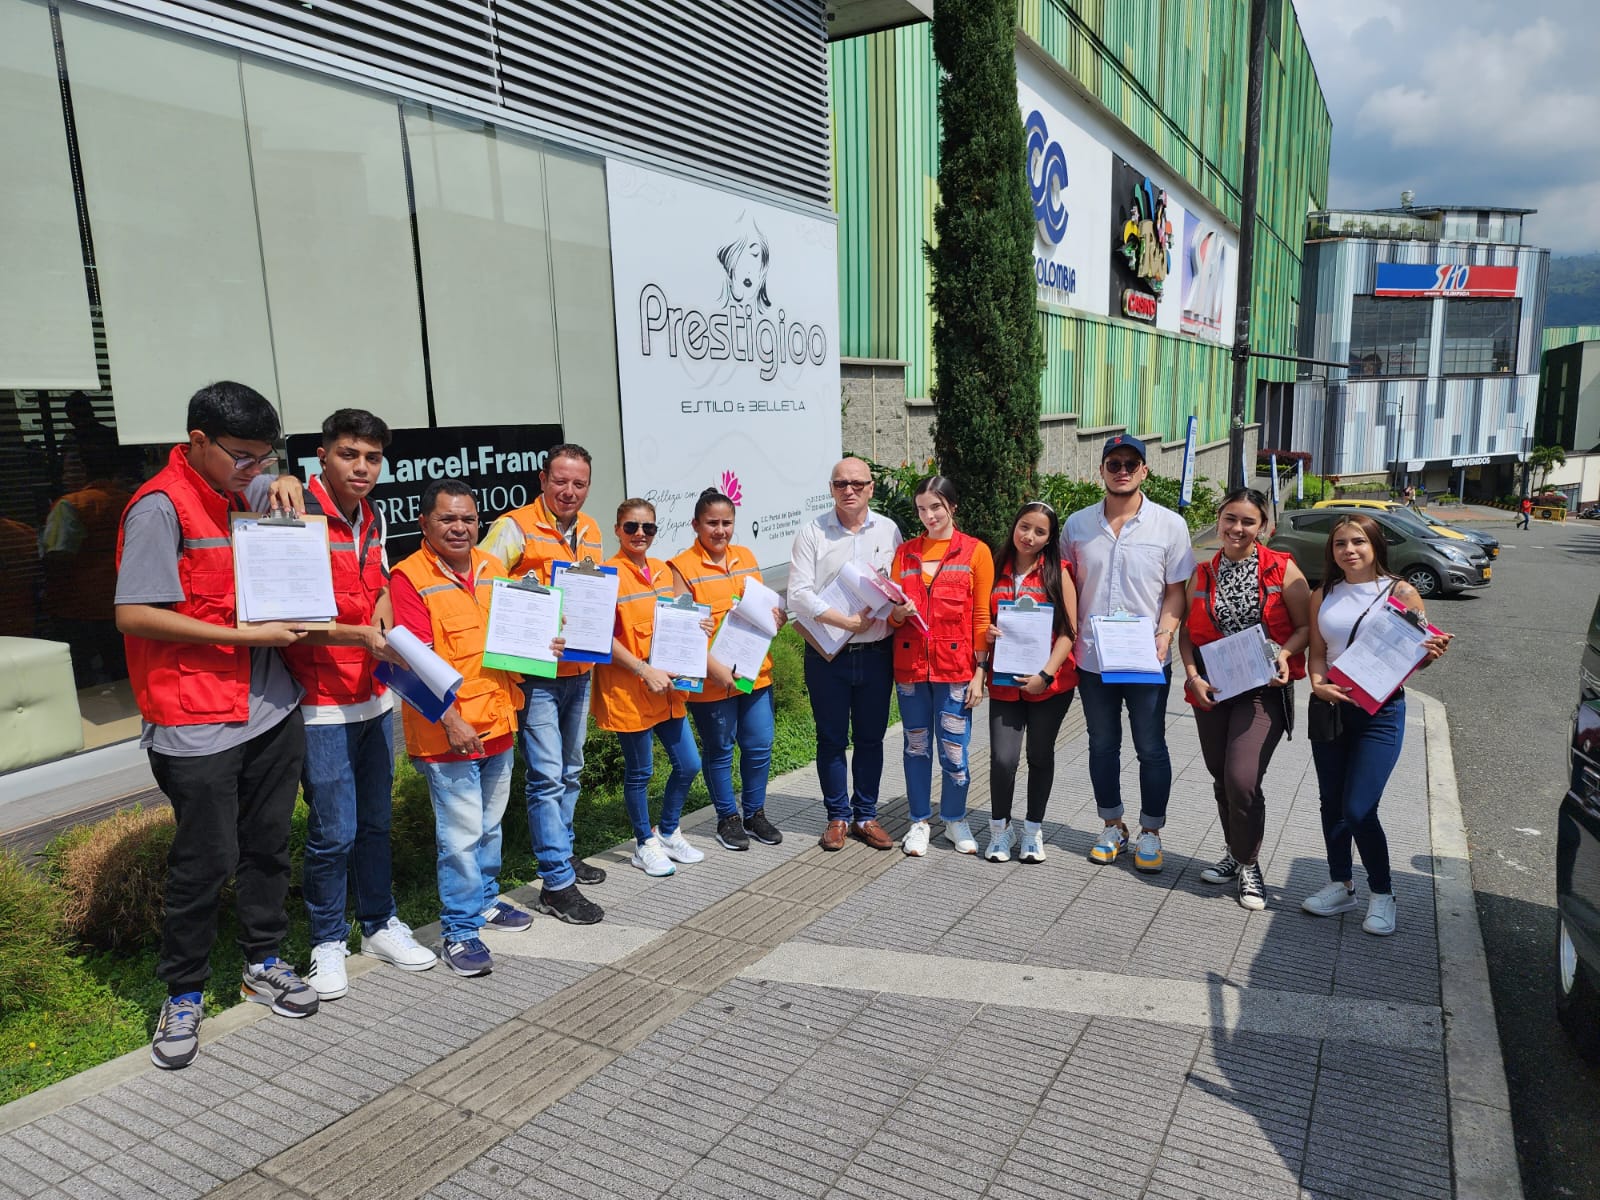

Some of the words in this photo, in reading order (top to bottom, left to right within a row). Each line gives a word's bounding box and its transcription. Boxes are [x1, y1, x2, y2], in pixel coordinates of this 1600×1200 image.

[1035, 257, 1076, 293] OLOMBIA
[640, 283, 827, 382] Prestigioo
[681, 400, 734, 414] ESTILO
[749, 400, 806, 412] BELLEZA
[1452, 457, 1491, 468] BIENVENIDOS
[376, 485, 527, 524] PREIOO
